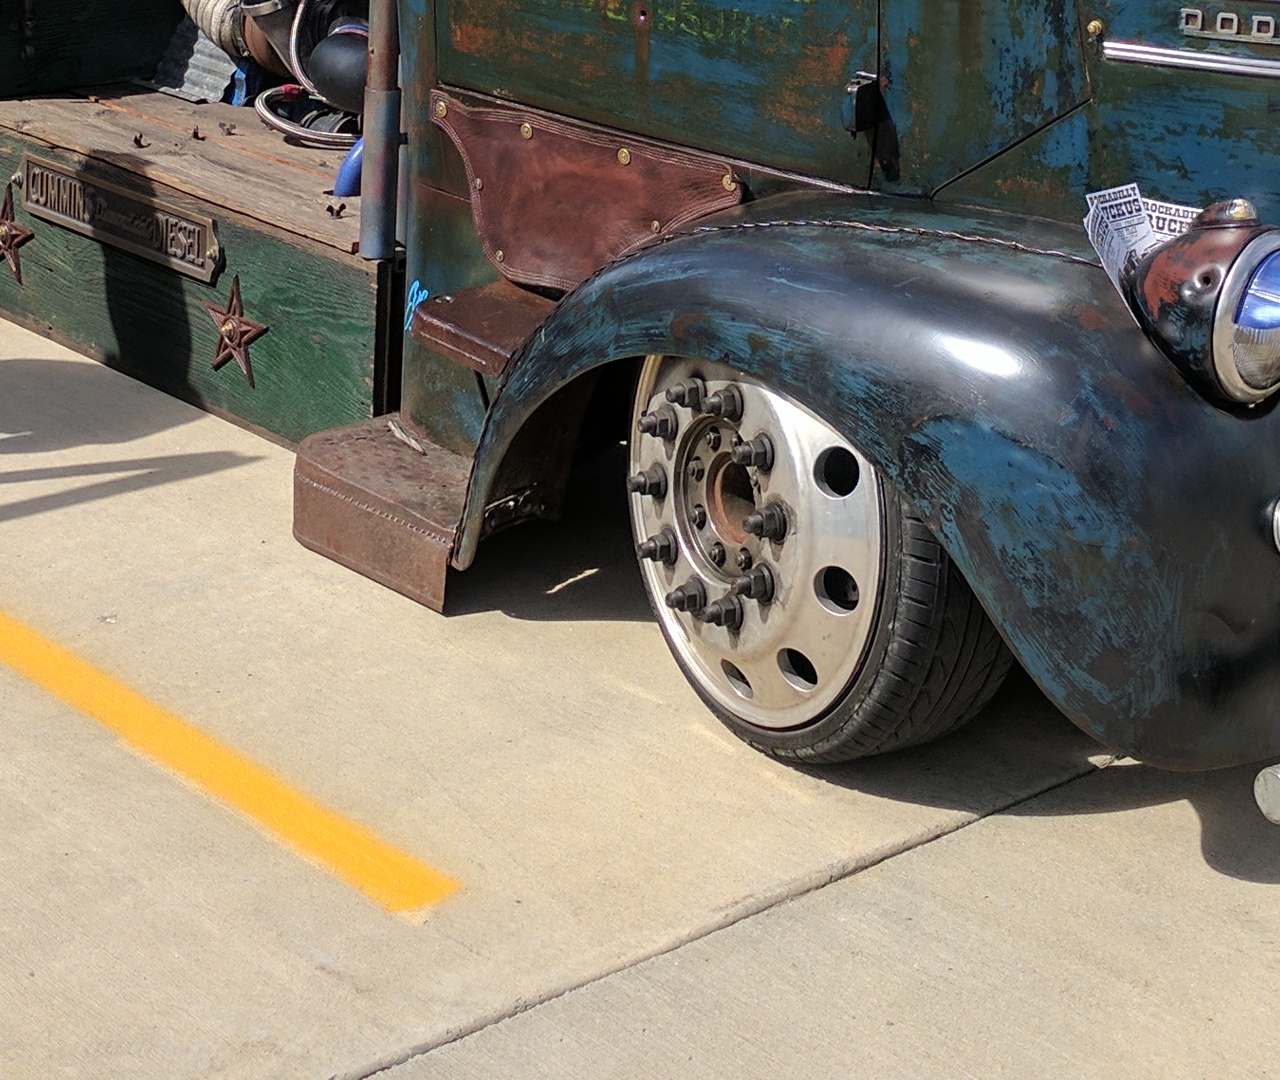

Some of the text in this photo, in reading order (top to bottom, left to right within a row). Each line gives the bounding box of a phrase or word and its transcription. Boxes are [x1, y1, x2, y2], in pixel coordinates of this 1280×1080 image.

[30, 167, 95, 222] CUMMINS
[152, 212, 206, 268] DIESEL
[1100, 198, 1142, 221] UCKUS
